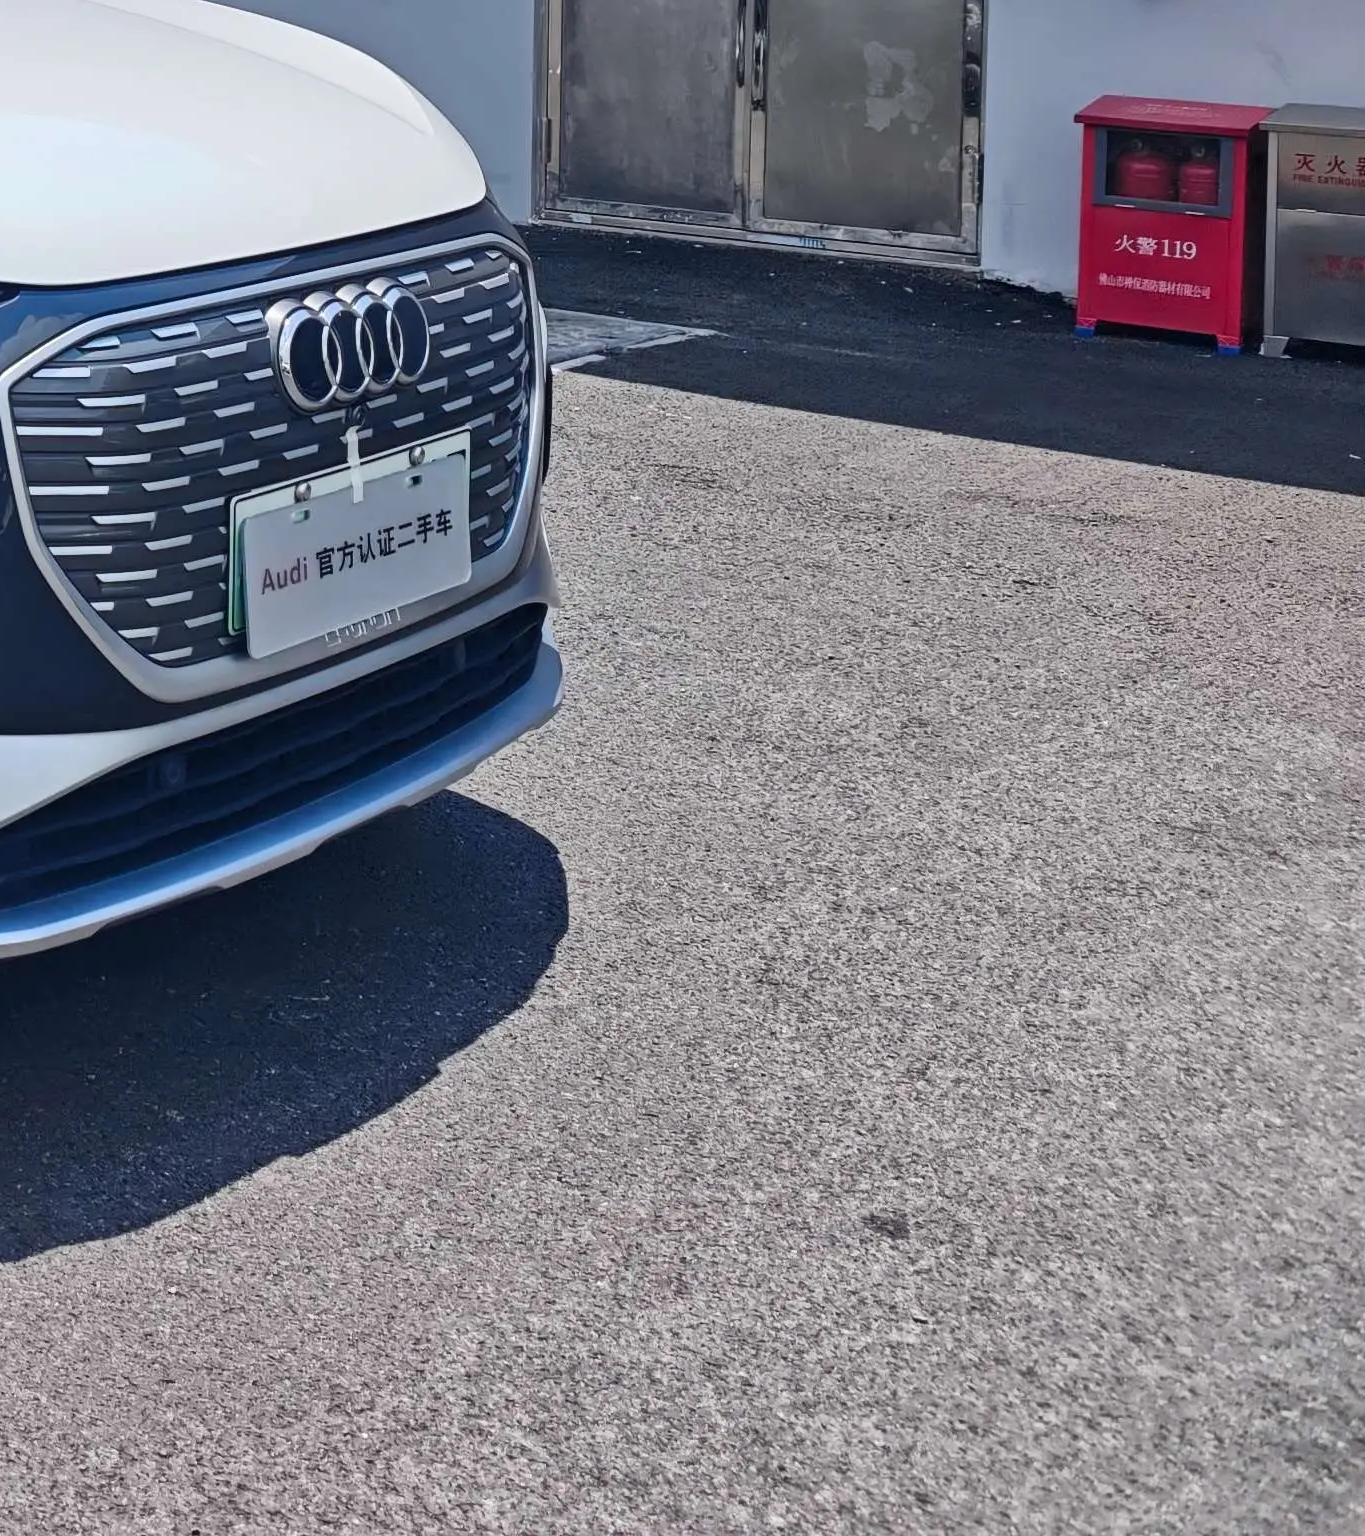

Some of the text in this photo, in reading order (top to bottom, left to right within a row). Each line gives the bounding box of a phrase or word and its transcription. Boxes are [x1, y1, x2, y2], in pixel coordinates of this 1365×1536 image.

[1114, 234, 1197, 260] 火警119
[261, 509, 454, 595] Audi 官方认证二手车
